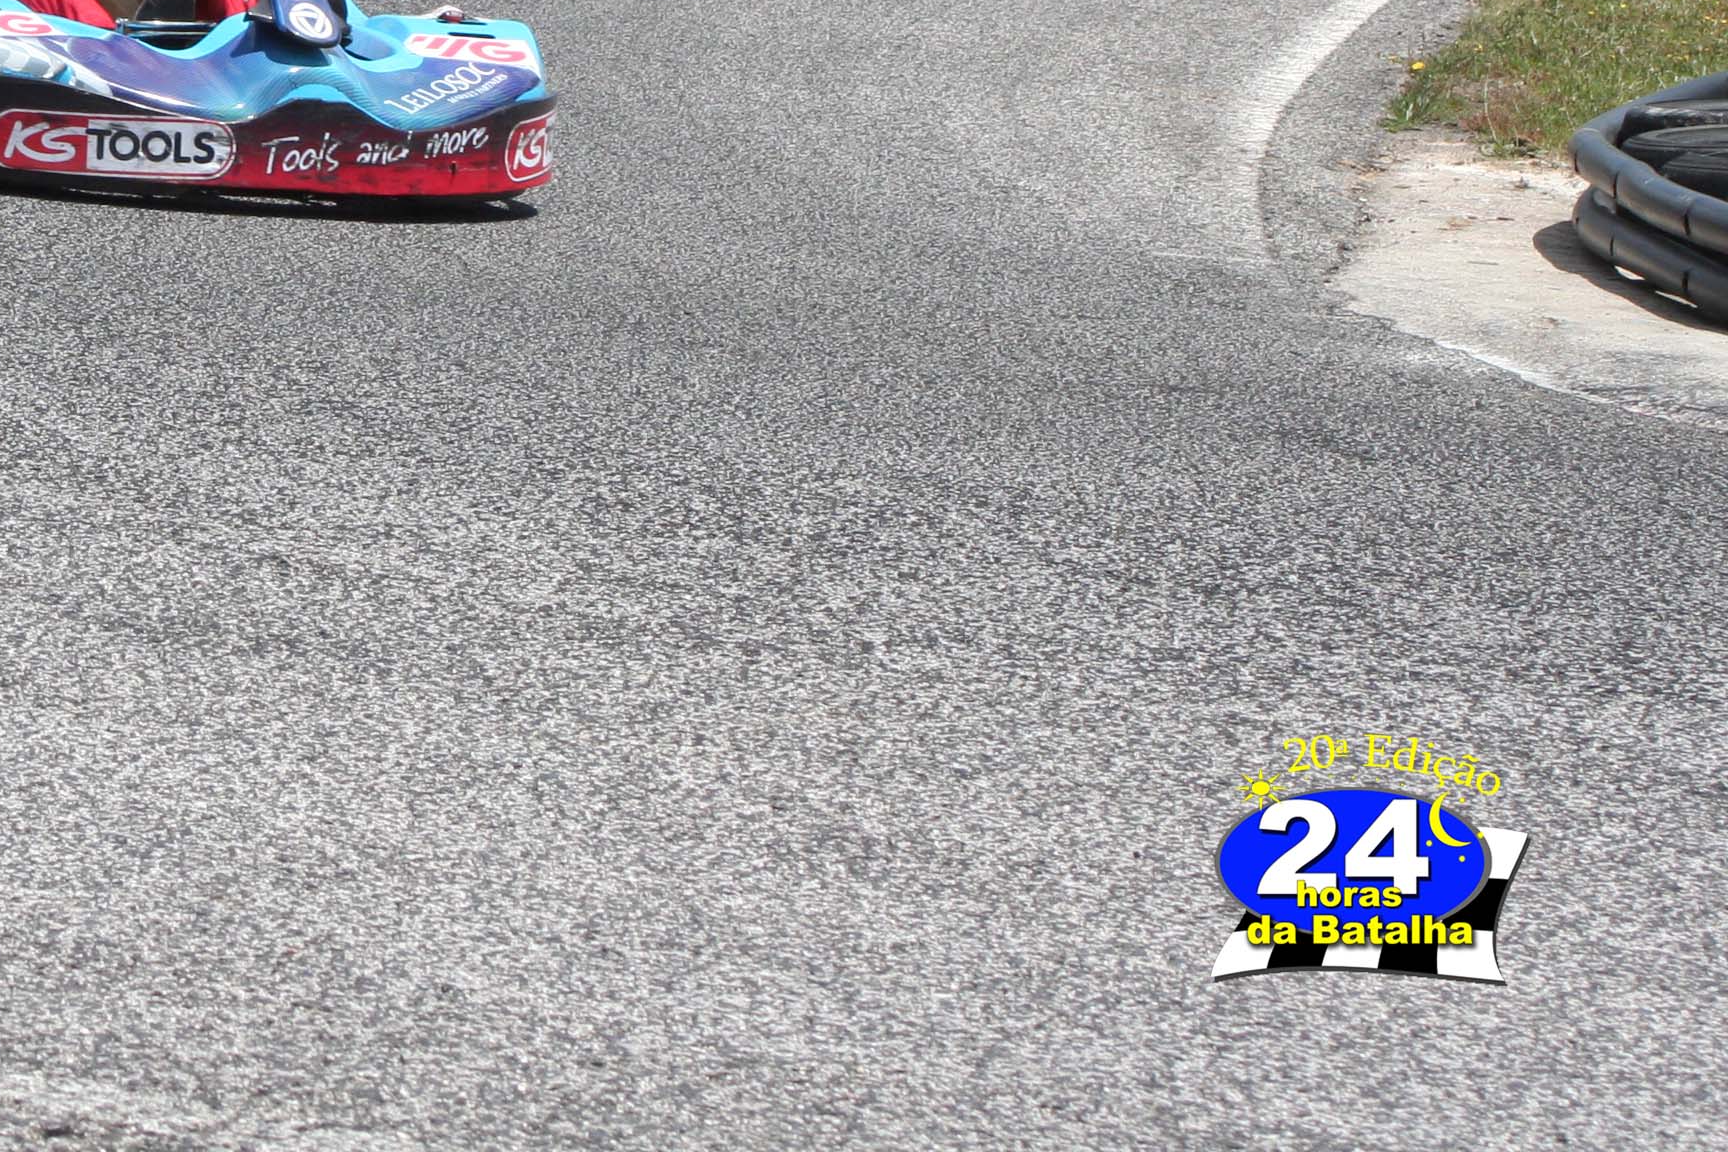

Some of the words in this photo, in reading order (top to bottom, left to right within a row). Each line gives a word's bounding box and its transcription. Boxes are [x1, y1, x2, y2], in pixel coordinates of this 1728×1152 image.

[85, 128, 216, 165] TOOLS
[261, 131, 342, 175] Tools
[356, 129, 413, 165] and
[424, 126, 490, 160] more
